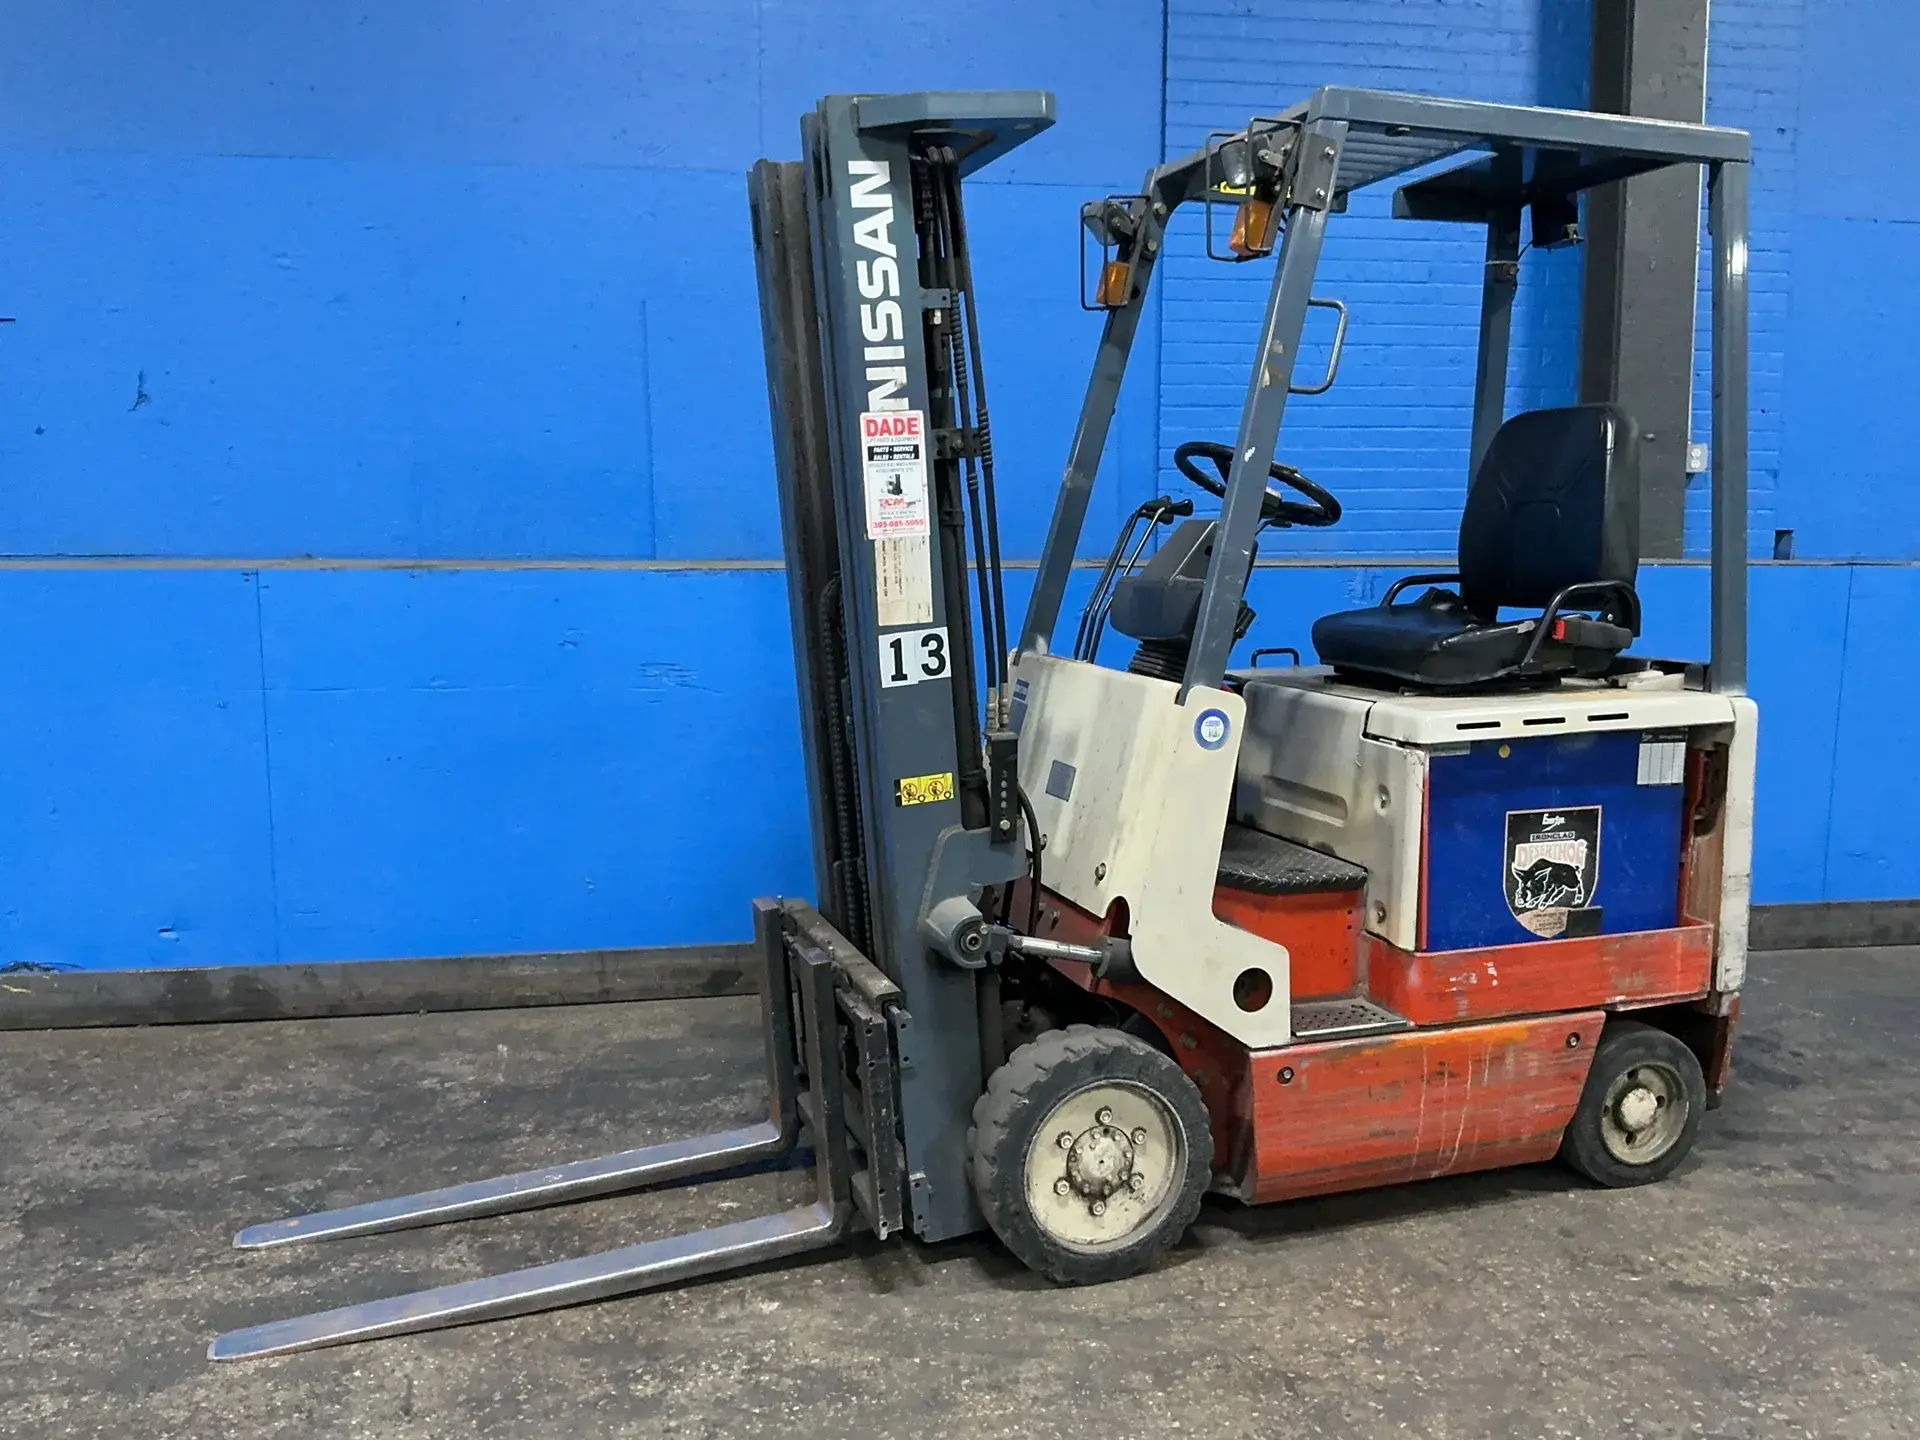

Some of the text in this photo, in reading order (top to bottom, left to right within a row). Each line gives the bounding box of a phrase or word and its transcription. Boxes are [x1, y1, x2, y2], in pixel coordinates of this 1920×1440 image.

[848, 160, 909, 412] NISSAN
[866, 417, 919, 437] DADE
[873, 453, 889, 461] SALES
[889, 633, 947, 682] 13
[1531, 832, 1574, 841] IRONCLAD
[1516, 840, 1587, 866] DESERTHOG
